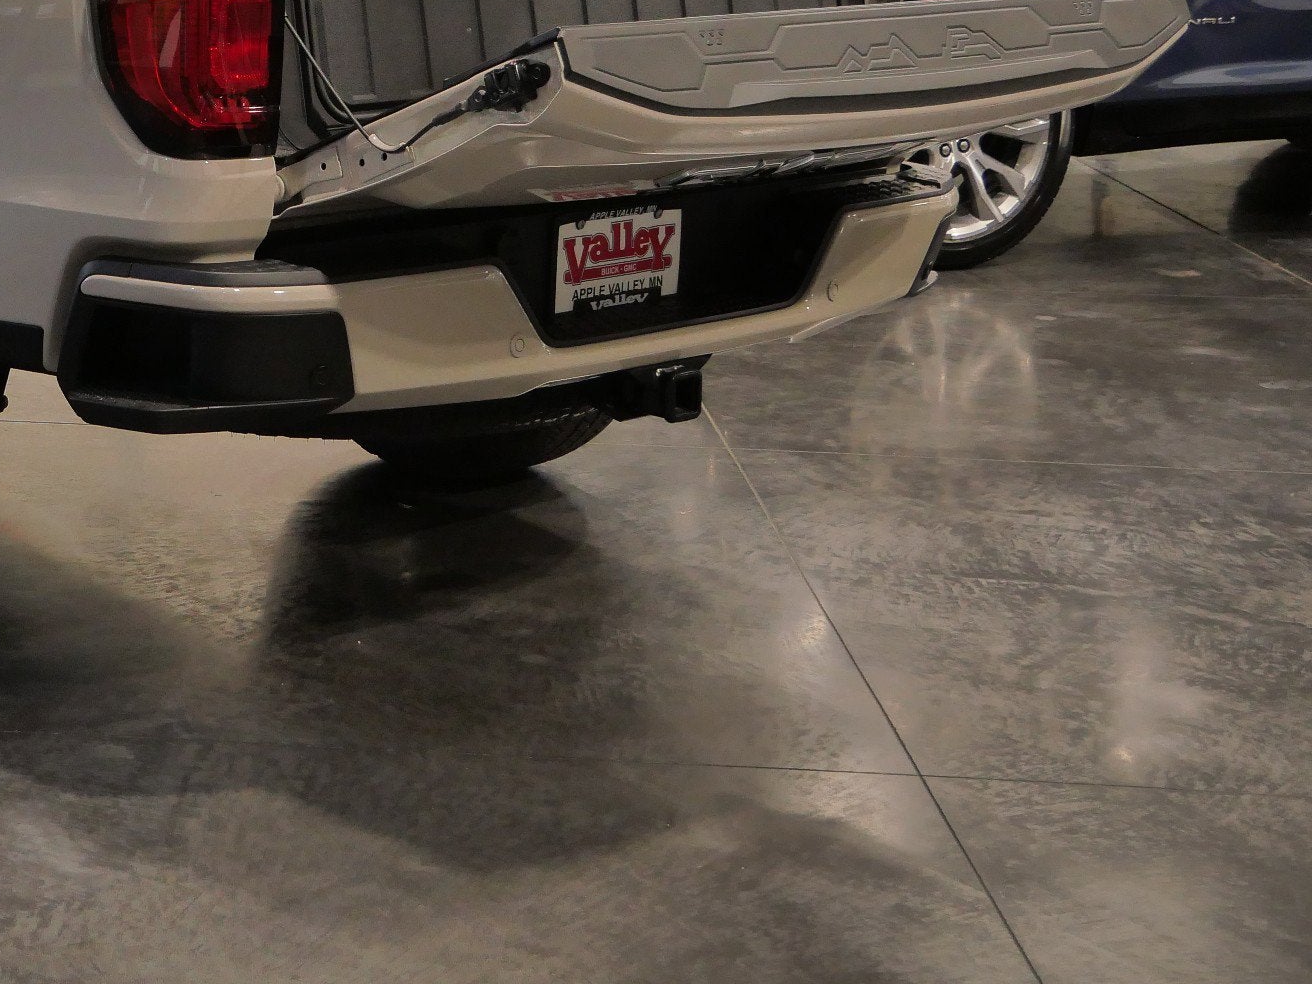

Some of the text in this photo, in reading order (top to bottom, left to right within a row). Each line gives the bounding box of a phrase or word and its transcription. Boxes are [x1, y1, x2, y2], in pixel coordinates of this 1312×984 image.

[1188, 16, 1236, 25] NALI
[590, 210, 616, 221] APPLE
[563, 219, 675, 286] Valley
[601, 263, 638, 276] BUICK GMC
[572, 285, 606, 302] APPLE
[649, 276, 664, 287] MN
[590, 293, 649, 311] Valley
